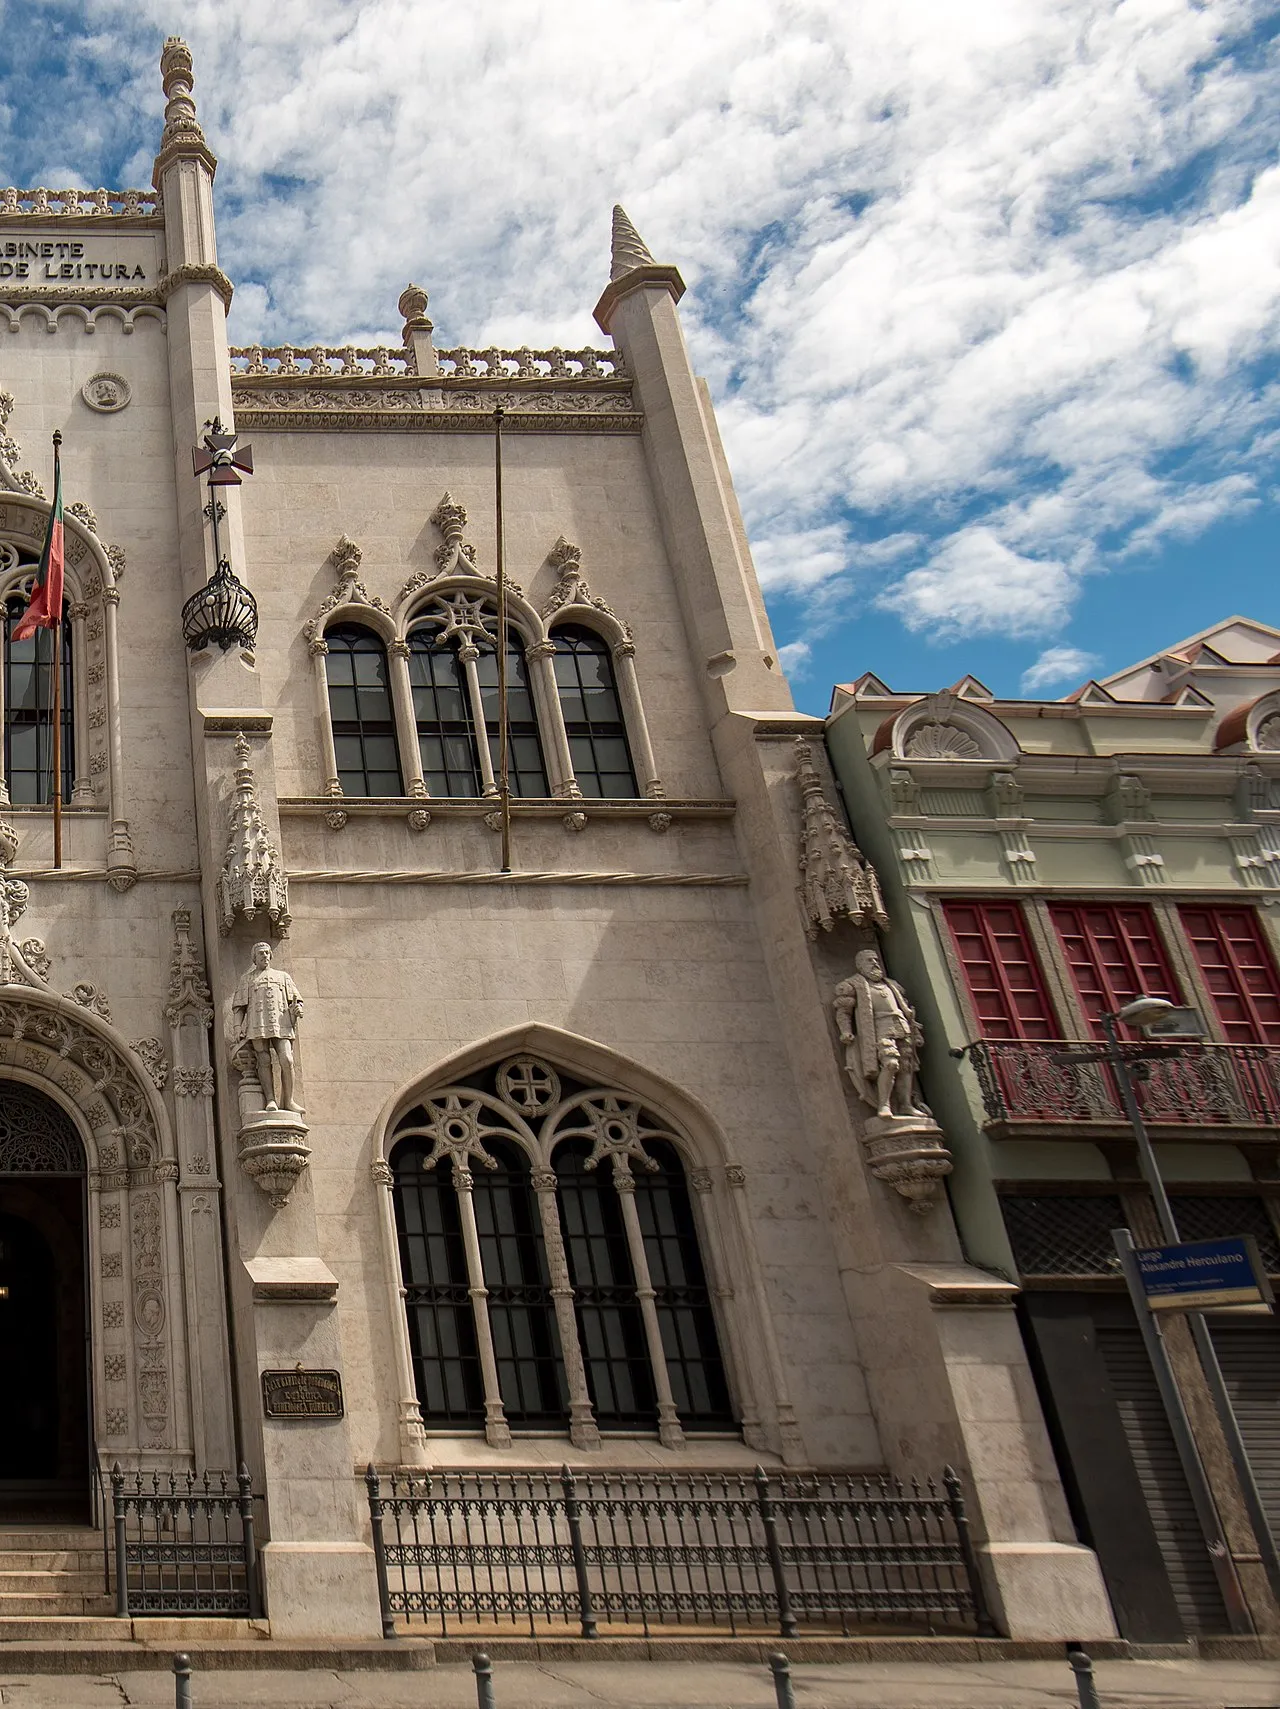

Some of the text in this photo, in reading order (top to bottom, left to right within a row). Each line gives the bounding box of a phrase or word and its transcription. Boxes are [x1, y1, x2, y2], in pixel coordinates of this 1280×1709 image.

[0, 262, 30, 277] DE
[45, 263, 146, 280] LEITURA
[1141, 1254, 1243, 1272] Alexandre Herculano
